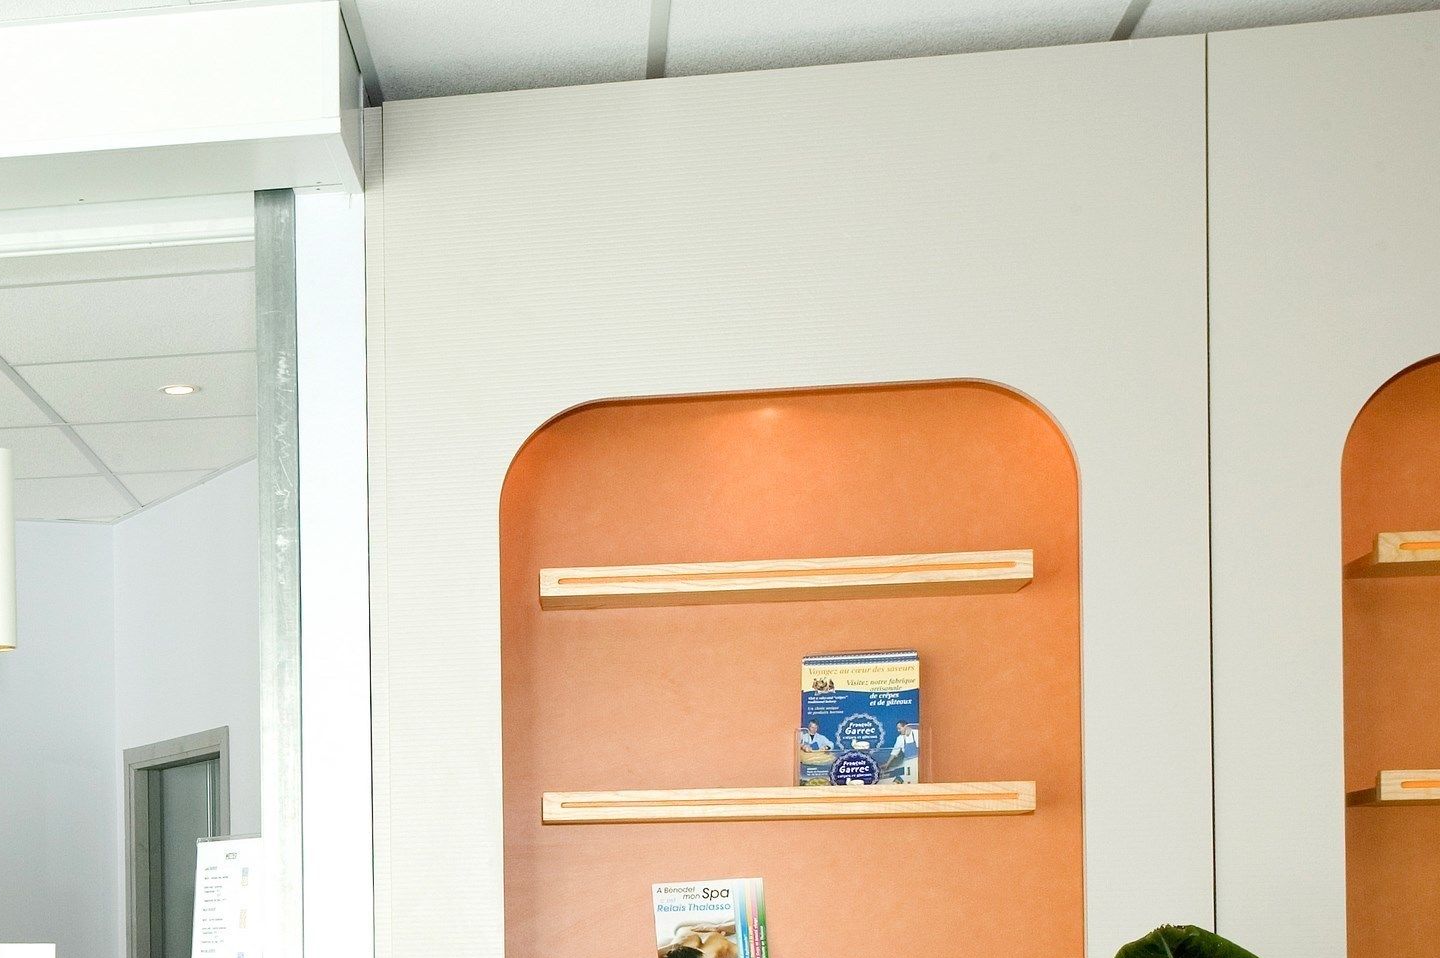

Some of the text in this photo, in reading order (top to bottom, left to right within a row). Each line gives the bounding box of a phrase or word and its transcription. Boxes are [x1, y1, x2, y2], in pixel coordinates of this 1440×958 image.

[888, 677, 916, 686] fabrique
[879, 692, 900, 700] crêpes
[886, 698, 913, 707] gâteaux
[845, 727, 876, 735] Garrec
[839, 766, 870, 774] Garrec
[702, 887, 730, 901] Spa
[657, 903, 731, 912] Relais Thalasso
